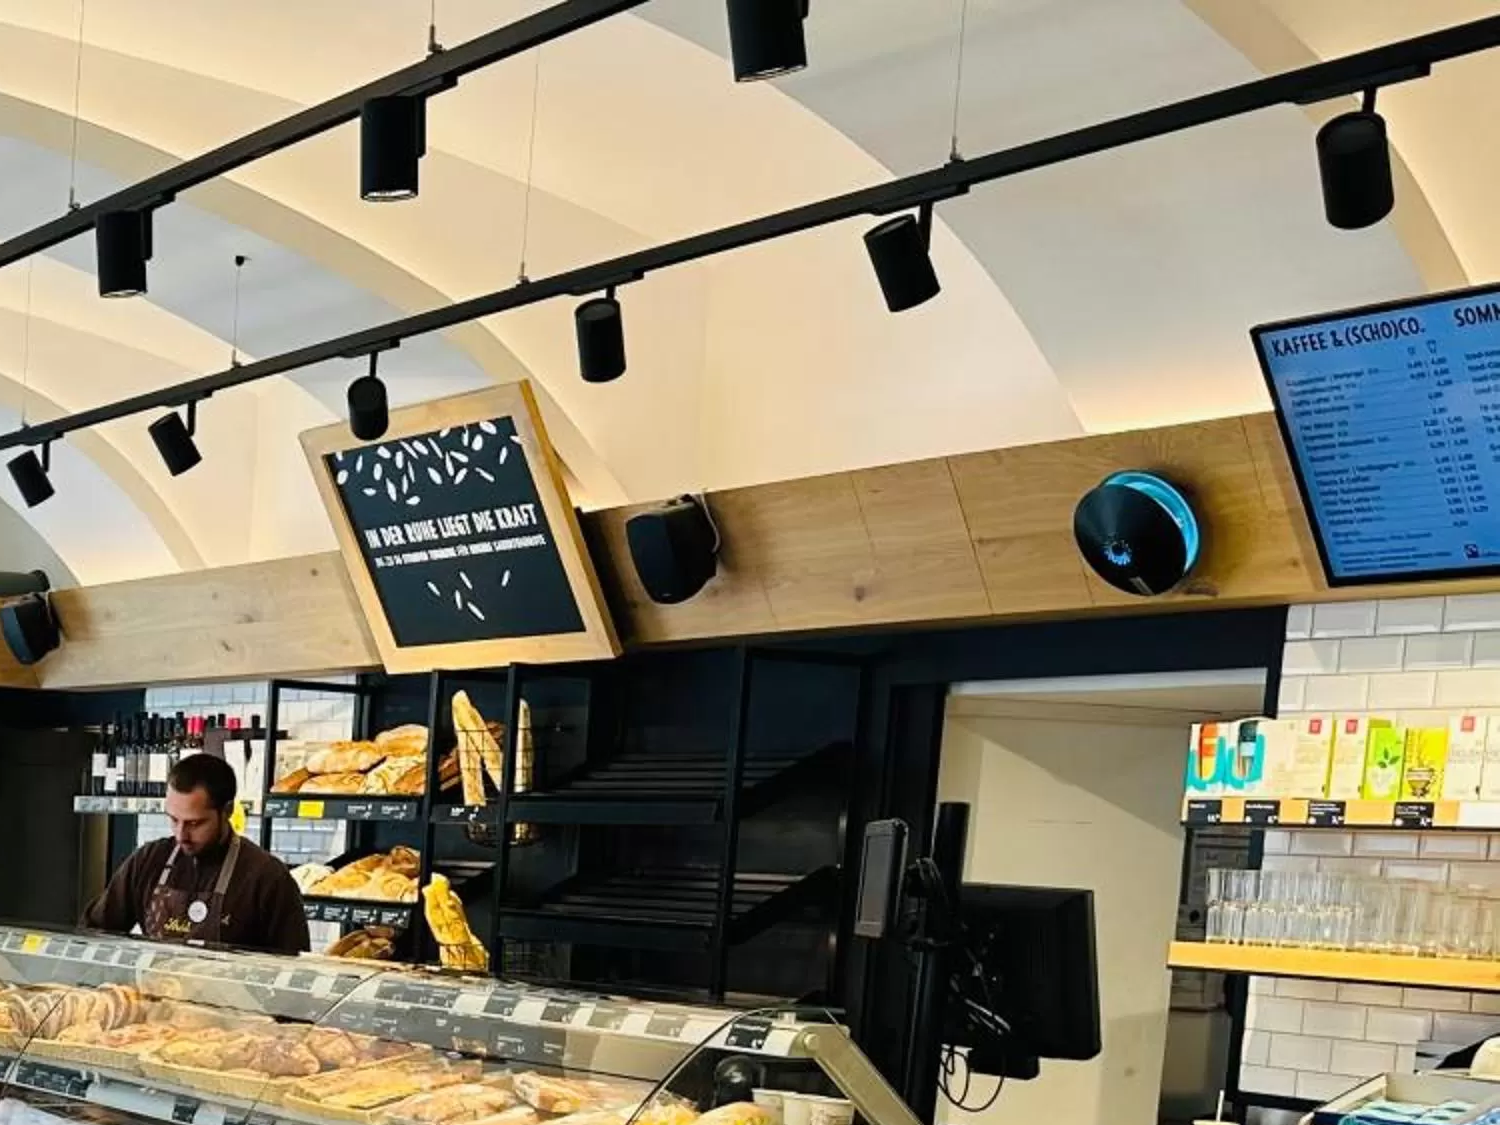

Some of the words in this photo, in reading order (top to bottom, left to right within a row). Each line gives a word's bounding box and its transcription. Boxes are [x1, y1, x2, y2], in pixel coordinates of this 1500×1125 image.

[1271, 331, 1328, 357] KAFFEE
[1330, 329, 1343, 347] &
[364, 529, 381, 548] IN
[380, 525, 406, 546] DER
[404, 519, 438, 542] RUHE
[437, 514, 472, 539] LIEGT
[472, 510, 496, 533] DIE
[495, 504, 537, 528] KRAFT
